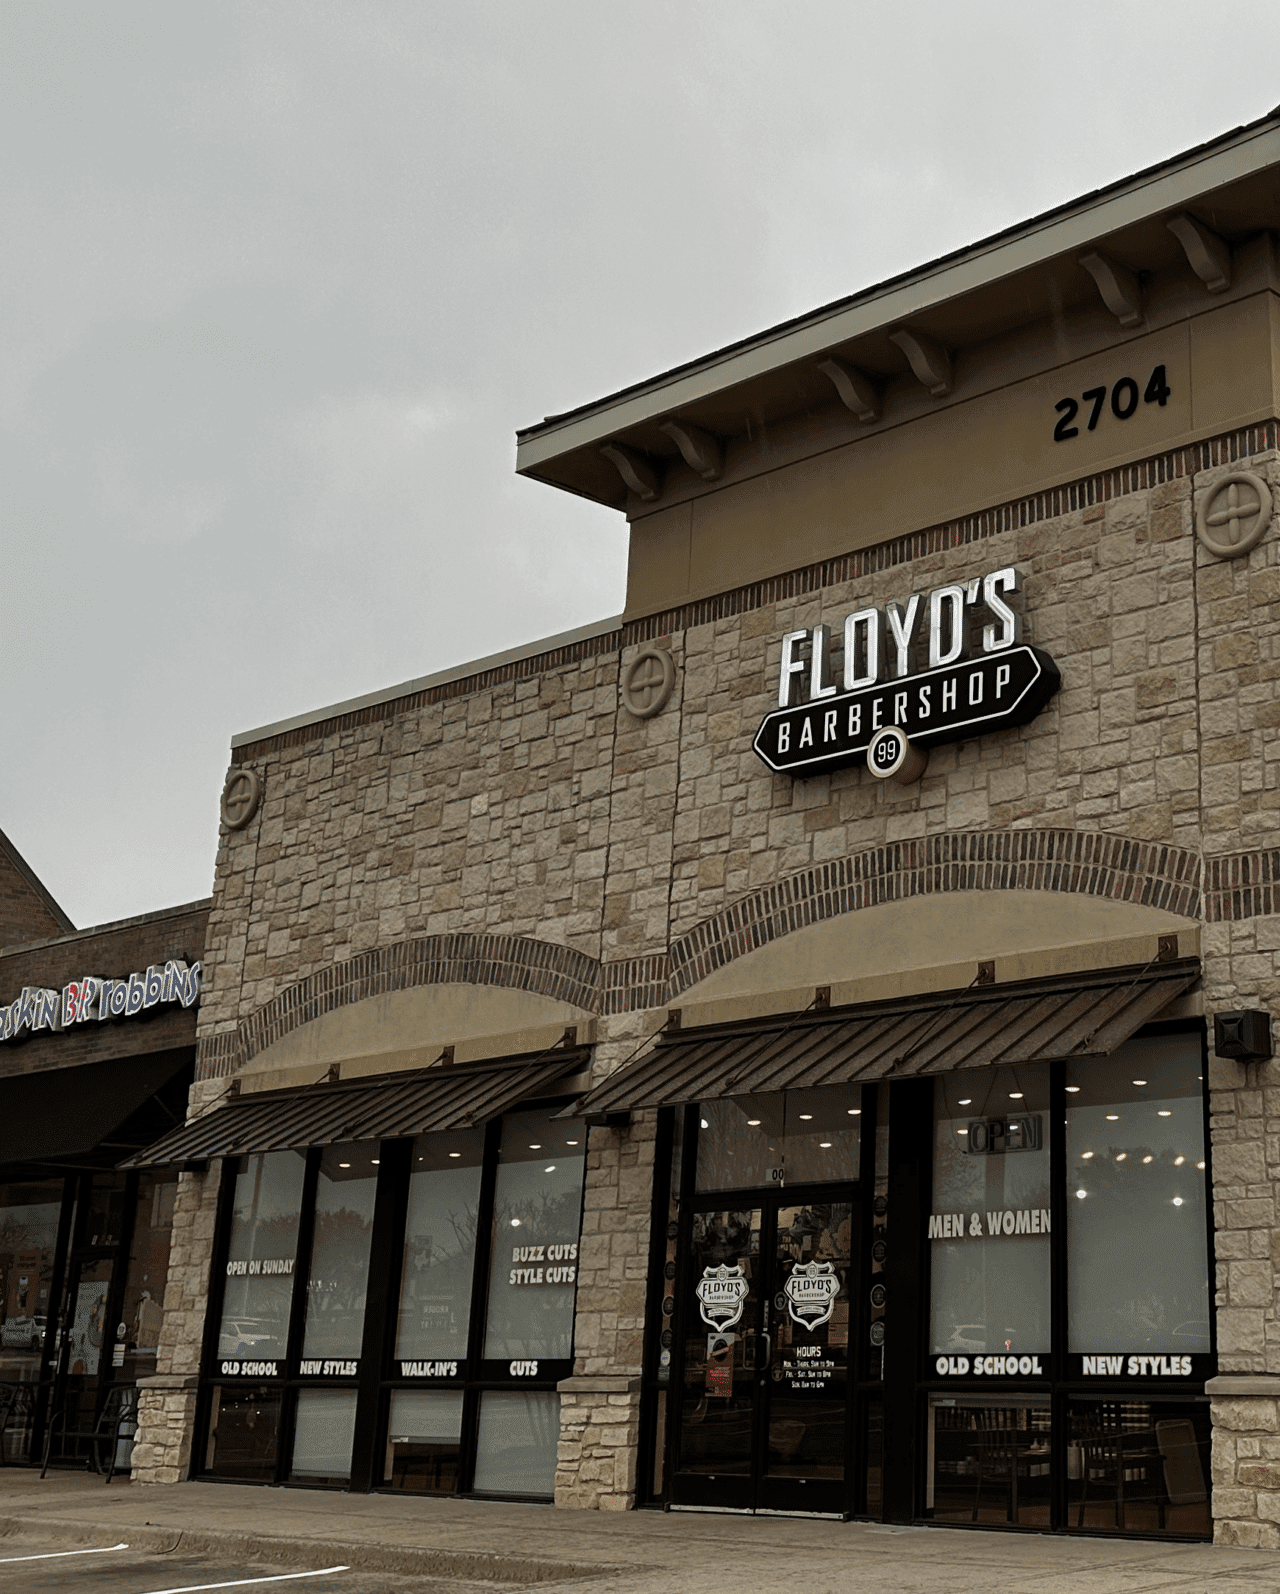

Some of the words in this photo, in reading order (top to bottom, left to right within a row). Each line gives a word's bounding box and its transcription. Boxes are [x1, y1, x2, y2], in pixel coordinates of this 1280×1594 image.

[1053, 364, 1171, 442] 2704
[778, 567, 1021, 708] FLOYD'S
[777, 665, 1011, 754] BARBERSHOP
[877, 739, 897, 763] 99
[970, 1117, 1038, 1152] OPEN
[928, 1213, 964, 1239] MEN
[969, 1212, 983, 1236] &
[987, 1209, 1051, 1236] WOMEN
[512, 1245, 545, 1262] BUZZ
[547, 1243, 578, 1260] CUTS
[226, 1261, 247, 1276] OPEN
[249, 1260, 261, 1275] ON
[262, 1258, 295, 1275] SUNDAY
[509, 1268, 543, 1285] STYLE
[546, 1266, 576, 1283] CUTS
[791, 1279, 832, 1296] FLOYD'S
[796, 1346, 822, 1357] HOURS
[221, 1361, 240, 1375] OLD
[241, 1361, 278, 1376] SCHOOL
[299, 1360, 322, 1375] NEW
[323, 1360, 358, 1376] STYLES
[401, 1361, 458, 1377] WALK-IN'S
[509, 1360, 538, 1377] CUTS
[936, 1356, 970, 1376] OLD
[973, 1356, 1043, 1376] SCHOOL
[1082, 1356, 1124, 1376] NEW
[1127, 1356, 1193, 1376] STYLES
